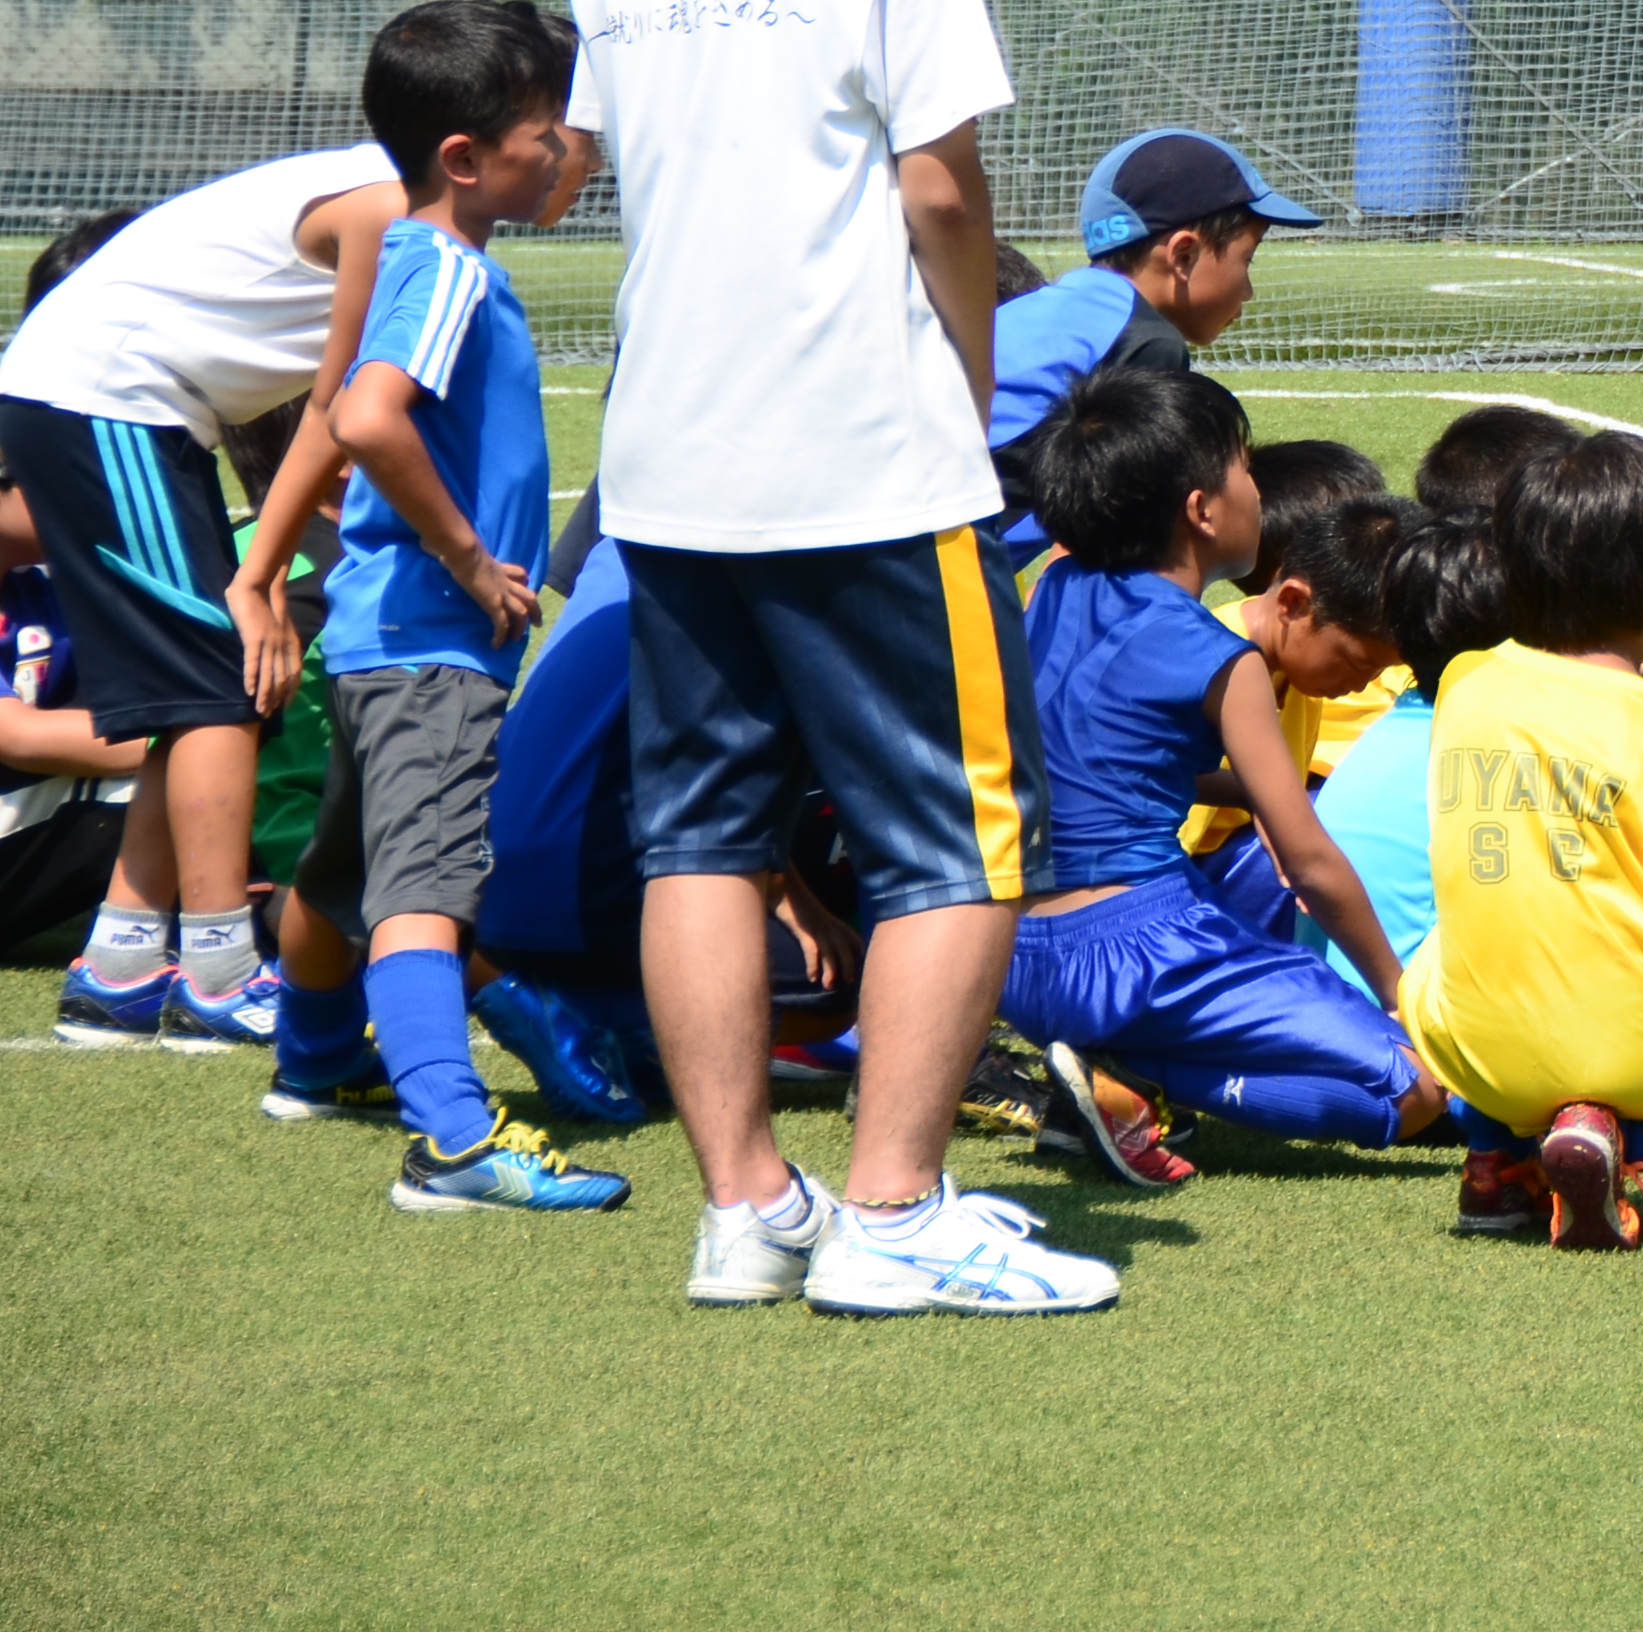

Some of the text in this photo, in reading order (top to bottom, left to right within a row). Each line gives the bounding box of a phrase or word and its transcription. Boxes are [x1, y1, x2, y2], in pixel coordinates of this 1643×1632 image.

[1437, 747, 1627, 827] UYAMA
[110, 933, 145, 946] PUMA
[191, 937, 222, 948] PUMA
